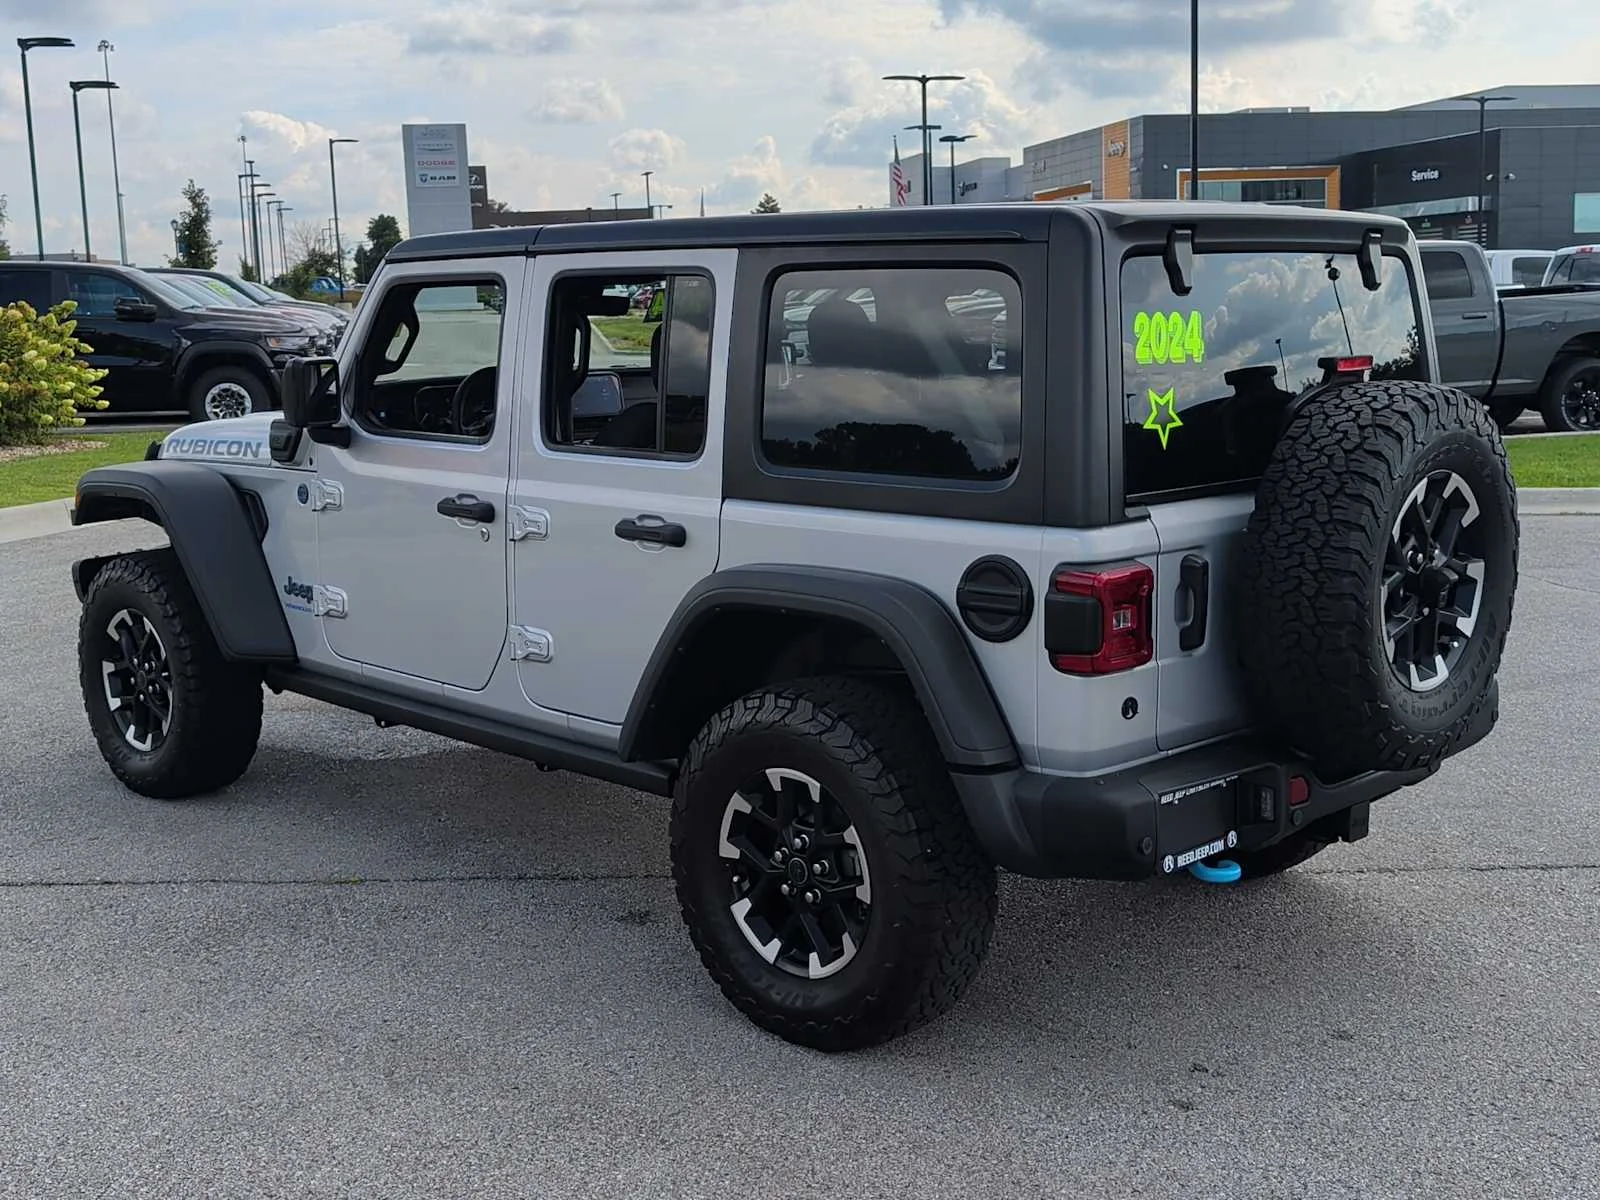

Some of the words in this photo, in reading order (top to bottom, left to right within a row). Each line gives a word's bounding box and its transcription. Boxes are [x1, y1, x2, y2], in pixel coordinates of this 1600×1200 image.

[1411, 168, 1439, 182] Service
[1134, 310, 1205, 365] 2024
[166, 438, 263, 458] RUBICON
[284, 576, 314, 604] Jeep
[1177, 839, 1225, 868] REEDJEEP.COM
